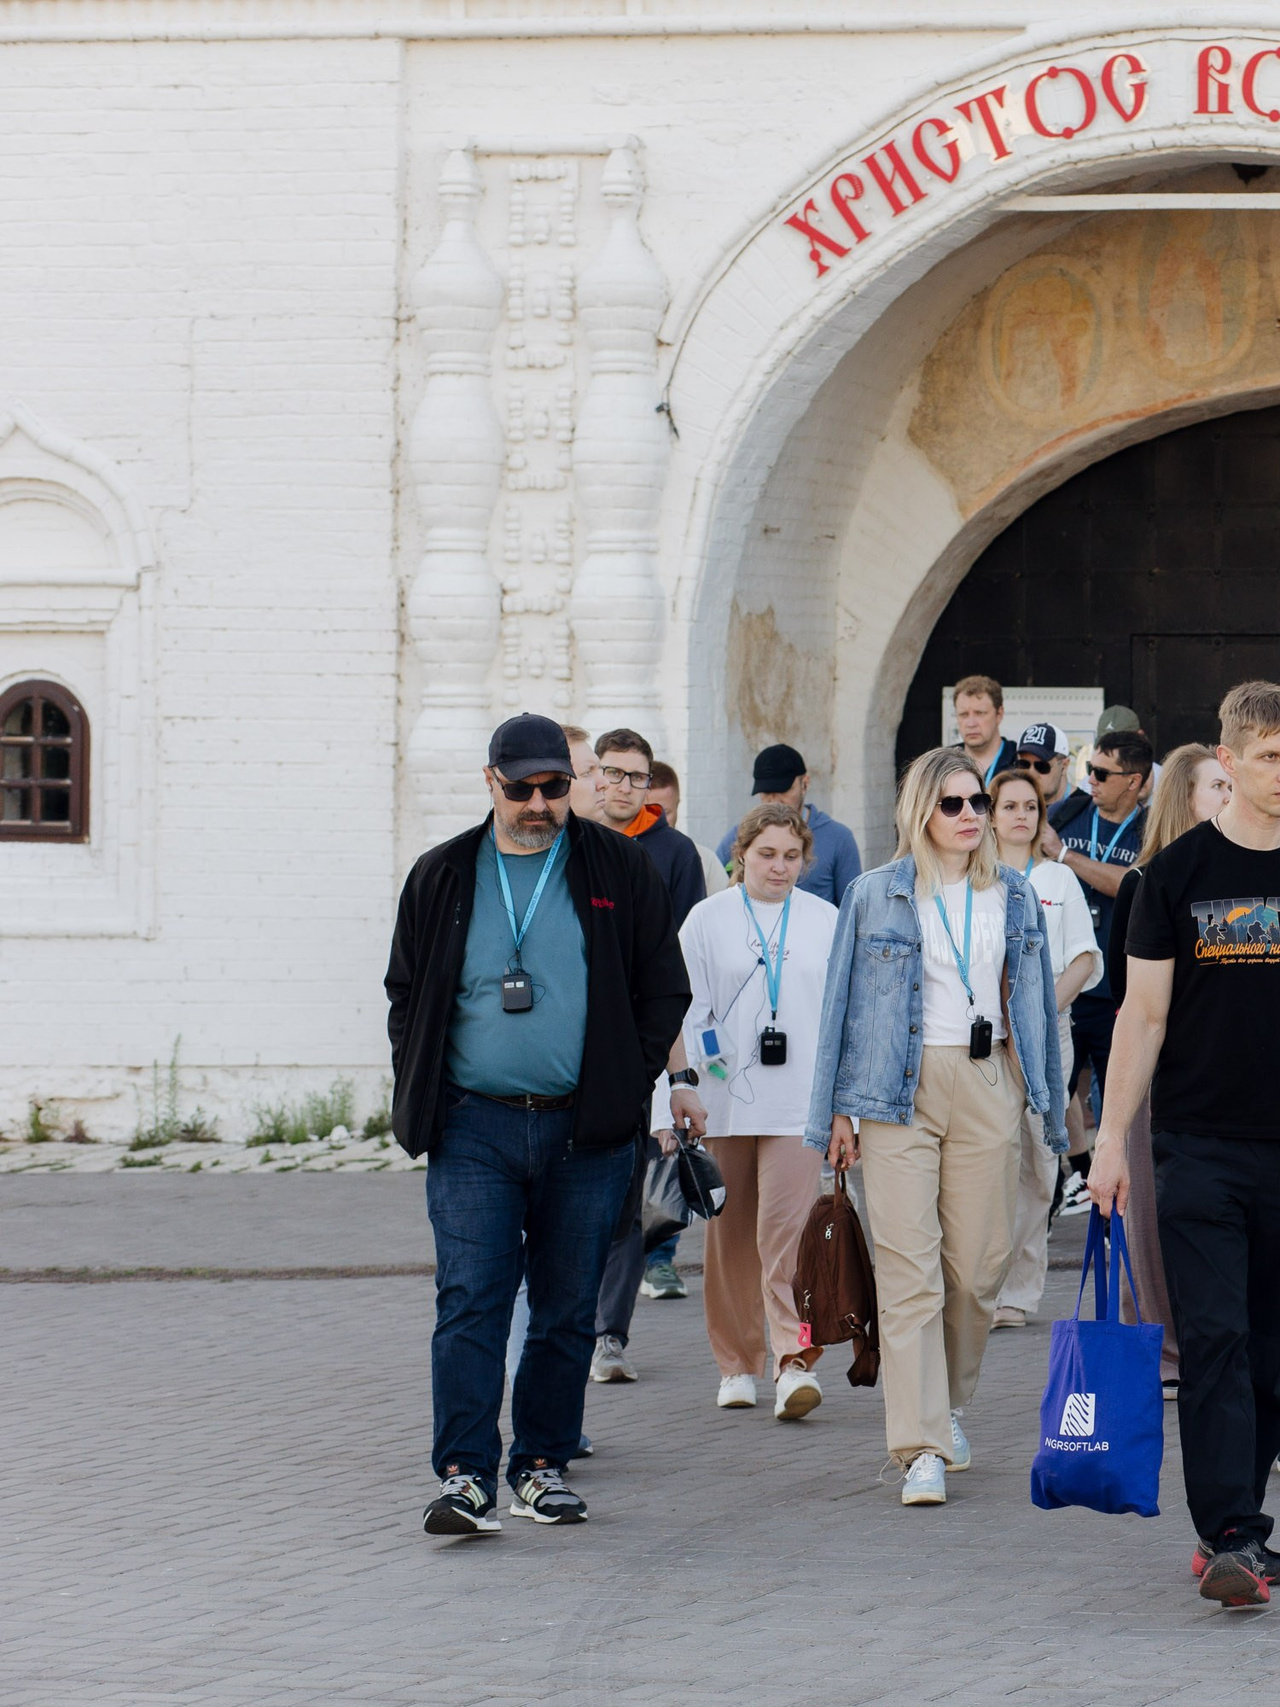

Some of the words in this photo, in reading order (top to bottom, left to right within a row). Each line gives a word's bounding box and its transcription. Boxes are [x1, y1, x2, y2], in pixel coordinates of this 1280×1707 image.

[784, 53, 1147, 277] ХРИСТОС
[1023, 725, 1047, 745] 21
[1195, 939, 1267, 960] Специального
[1045, 1437, 1109, 1451] NGRSOFTLAB
